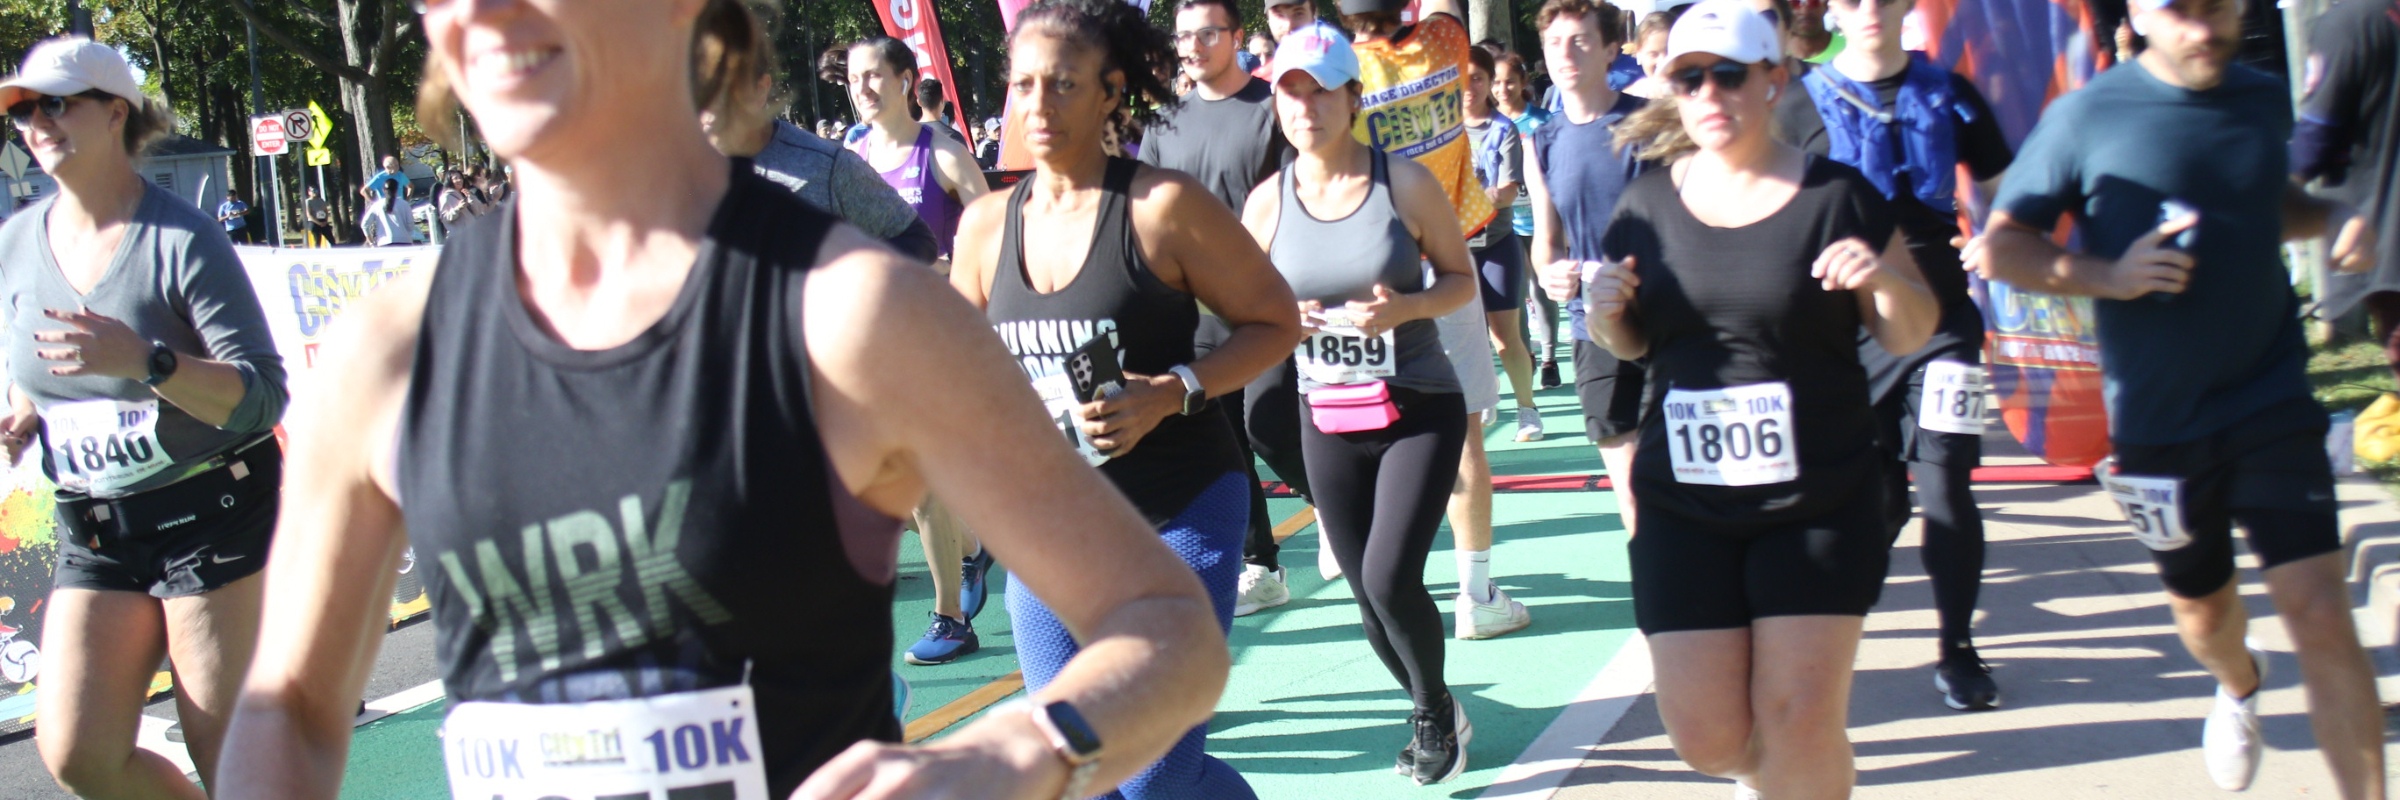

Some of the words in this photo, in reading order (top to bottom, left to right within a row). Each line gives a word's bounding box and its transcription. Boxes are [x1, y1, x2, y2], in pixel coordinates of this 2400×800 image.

[1400, 67, 1458, 96] DIRECTOR
[261, 140, 280, 148] ENTER
[993, 319, 1119, 355] UNNING
[1300, 335, 1386, 367] 1859
[1667, 402, 1698, 420] 10K
[1746, 395, 1785, 415] 10K
[60, 431, 154, 474] 1840
[1675, 418, 1782, 464] 1806
[439, 478, 735, 682] WRK
[456, 737, 525, 780] 10K
[643, 717, 752, 773] 10K
